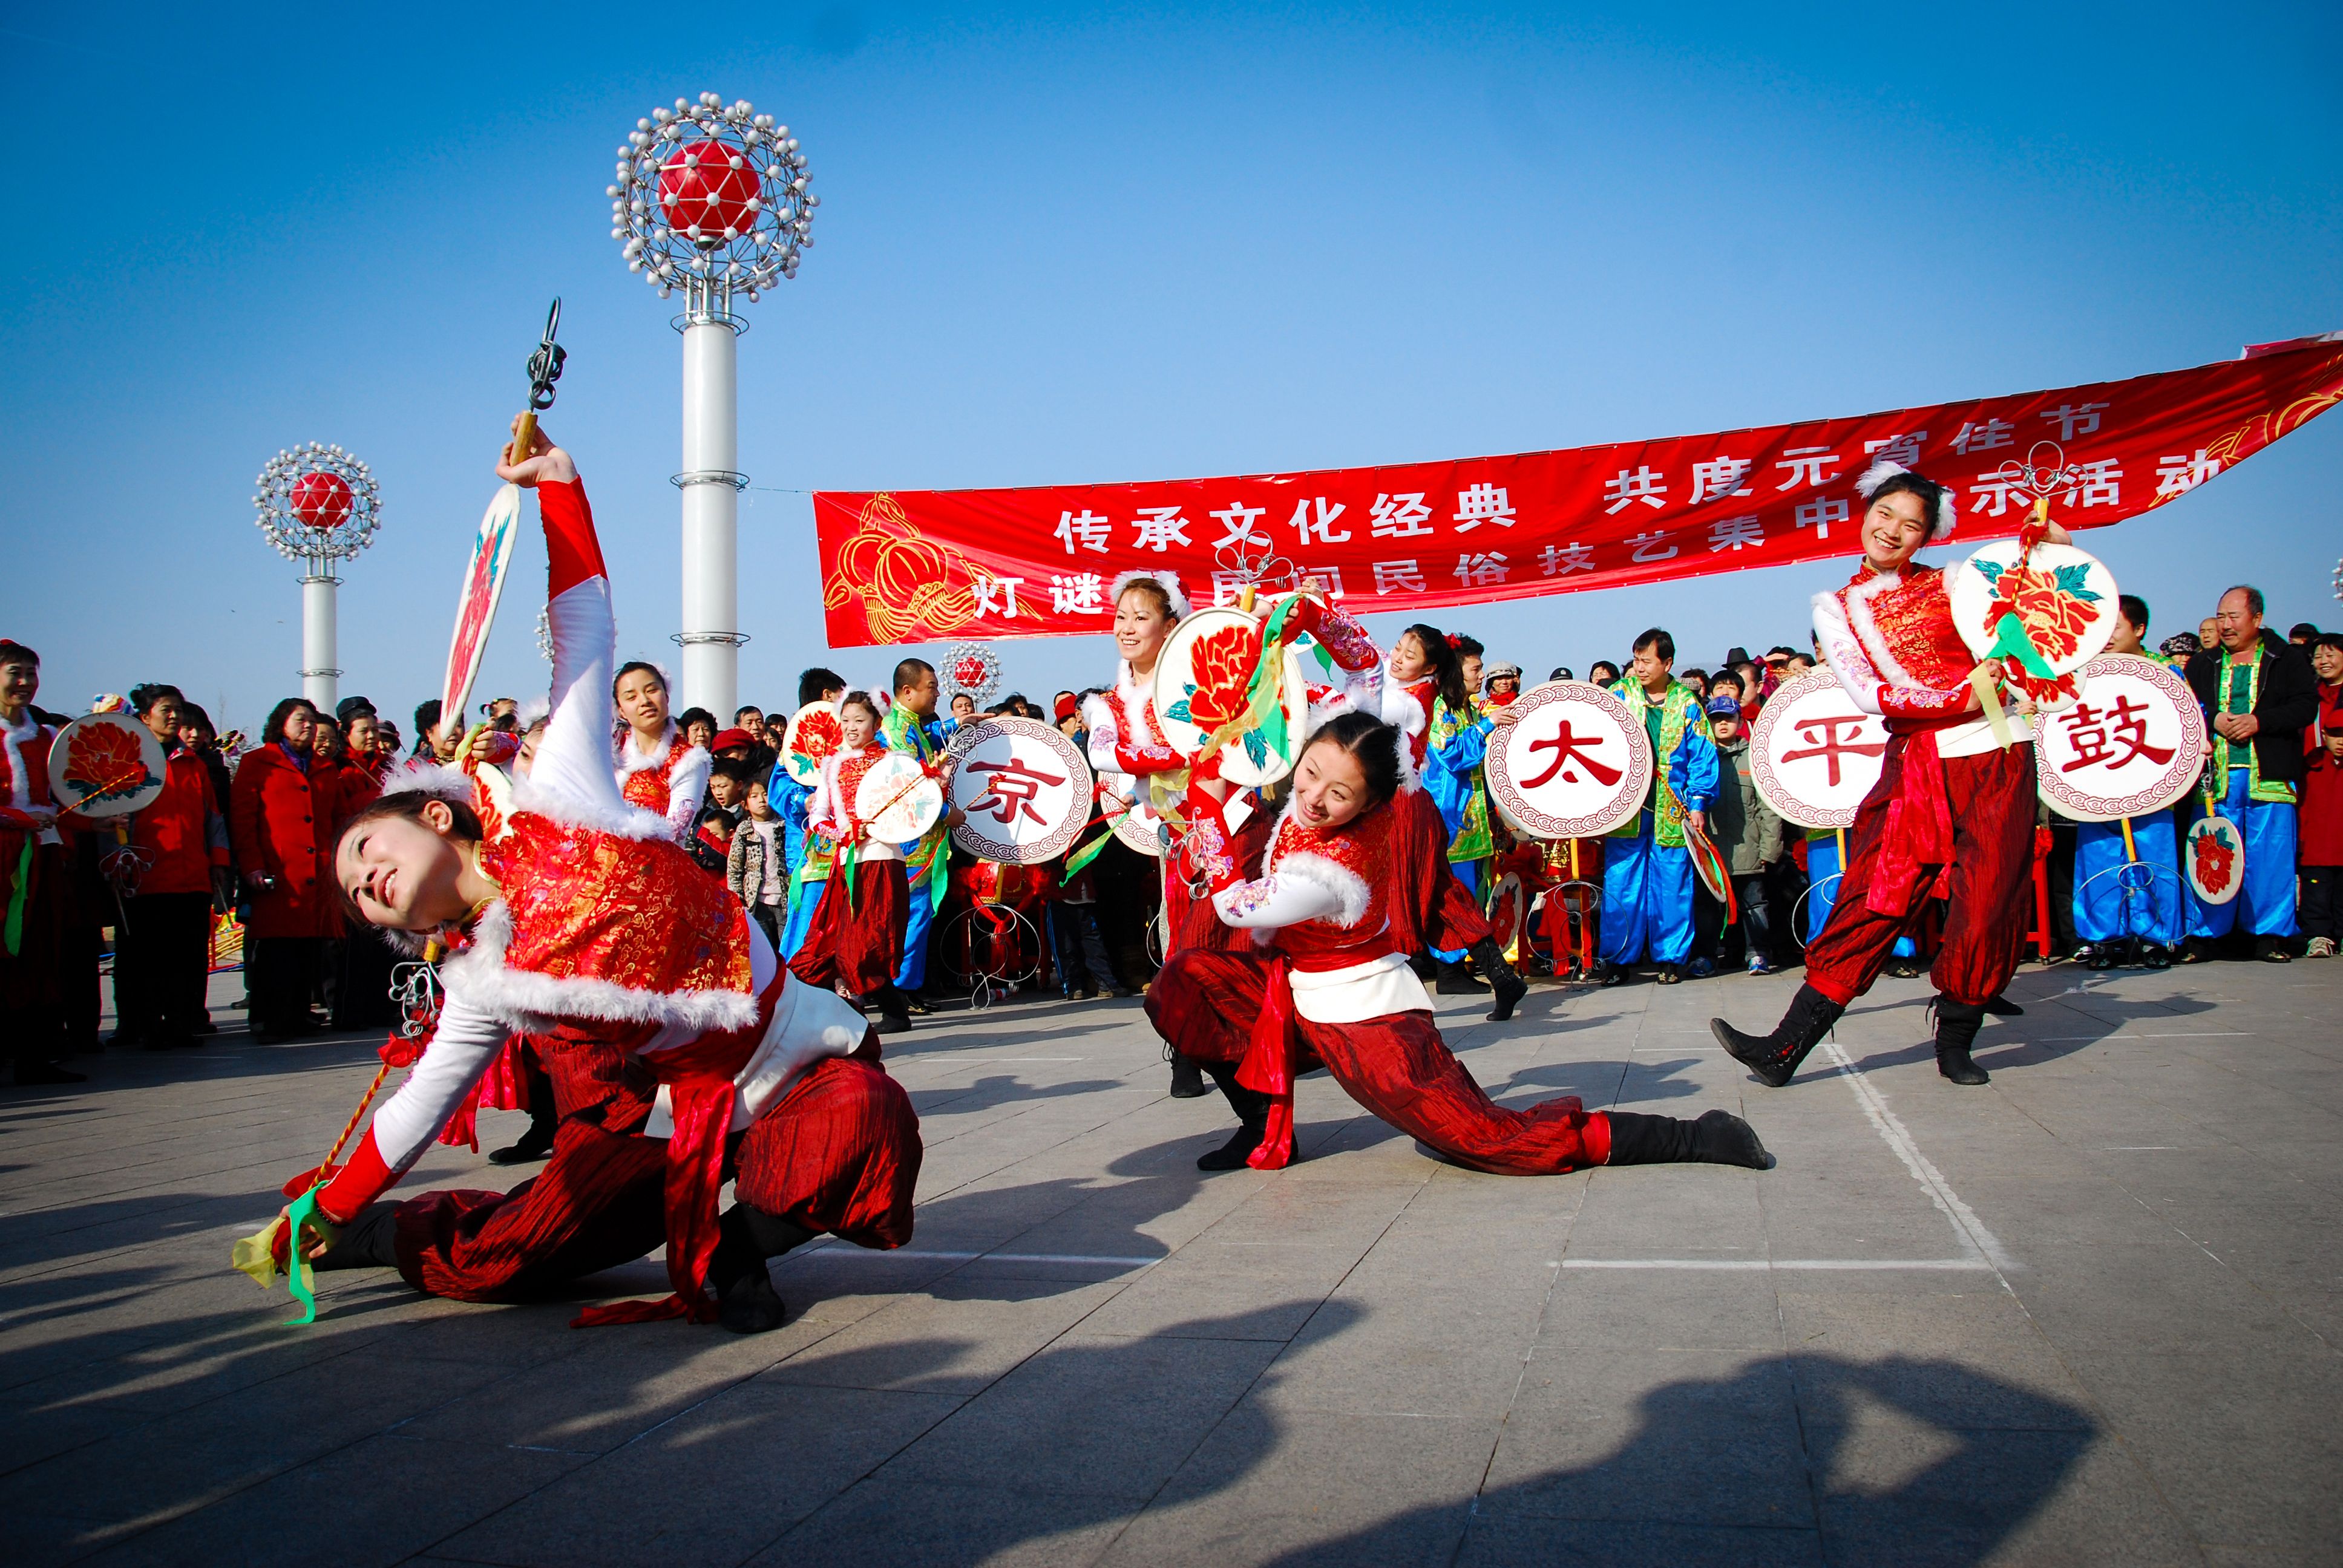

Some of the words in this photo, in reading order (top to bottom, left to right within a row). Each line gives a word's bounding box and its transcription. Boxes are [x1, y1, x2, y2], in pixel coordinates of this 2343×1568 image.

[1054, 483, 1516, 554] 传承文化经典
[1605, 402, 2110, 514] 共度元宵佳节
[971, 448, 2220, 619] 灯谜民间民俗技艺集中示活动
[1519, 719, 1623, 789] 太
[1781, 715, 1887, 787] 平
[2058, 695, 2176, 773] 鼓
[966, 758, 1066, 826] 京
